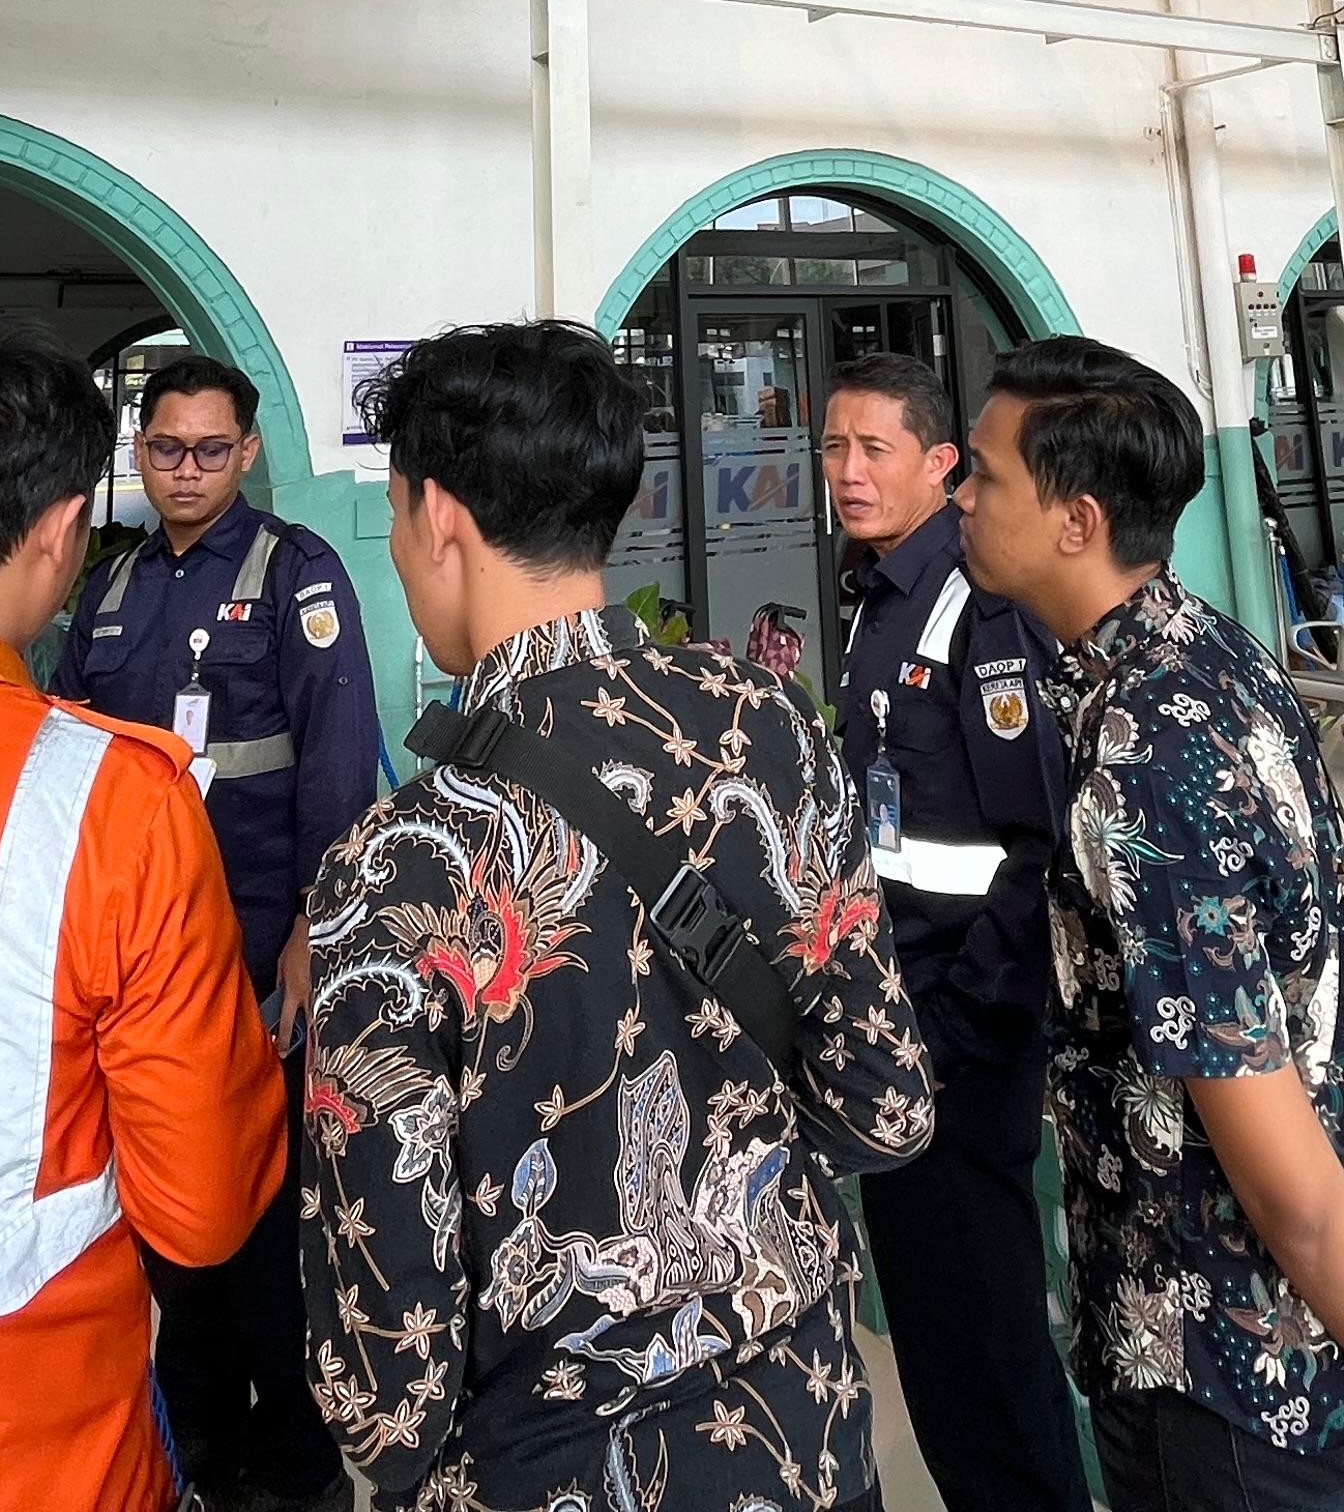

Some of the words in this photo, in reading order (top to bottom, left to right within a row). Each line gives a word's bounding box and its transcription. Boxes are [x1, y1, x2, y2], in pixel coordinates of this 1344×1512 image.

[717, 463, 800, 514] KAI
[216, 603, 252, 621] KAI
[898, 662, 931, 690] KAI
